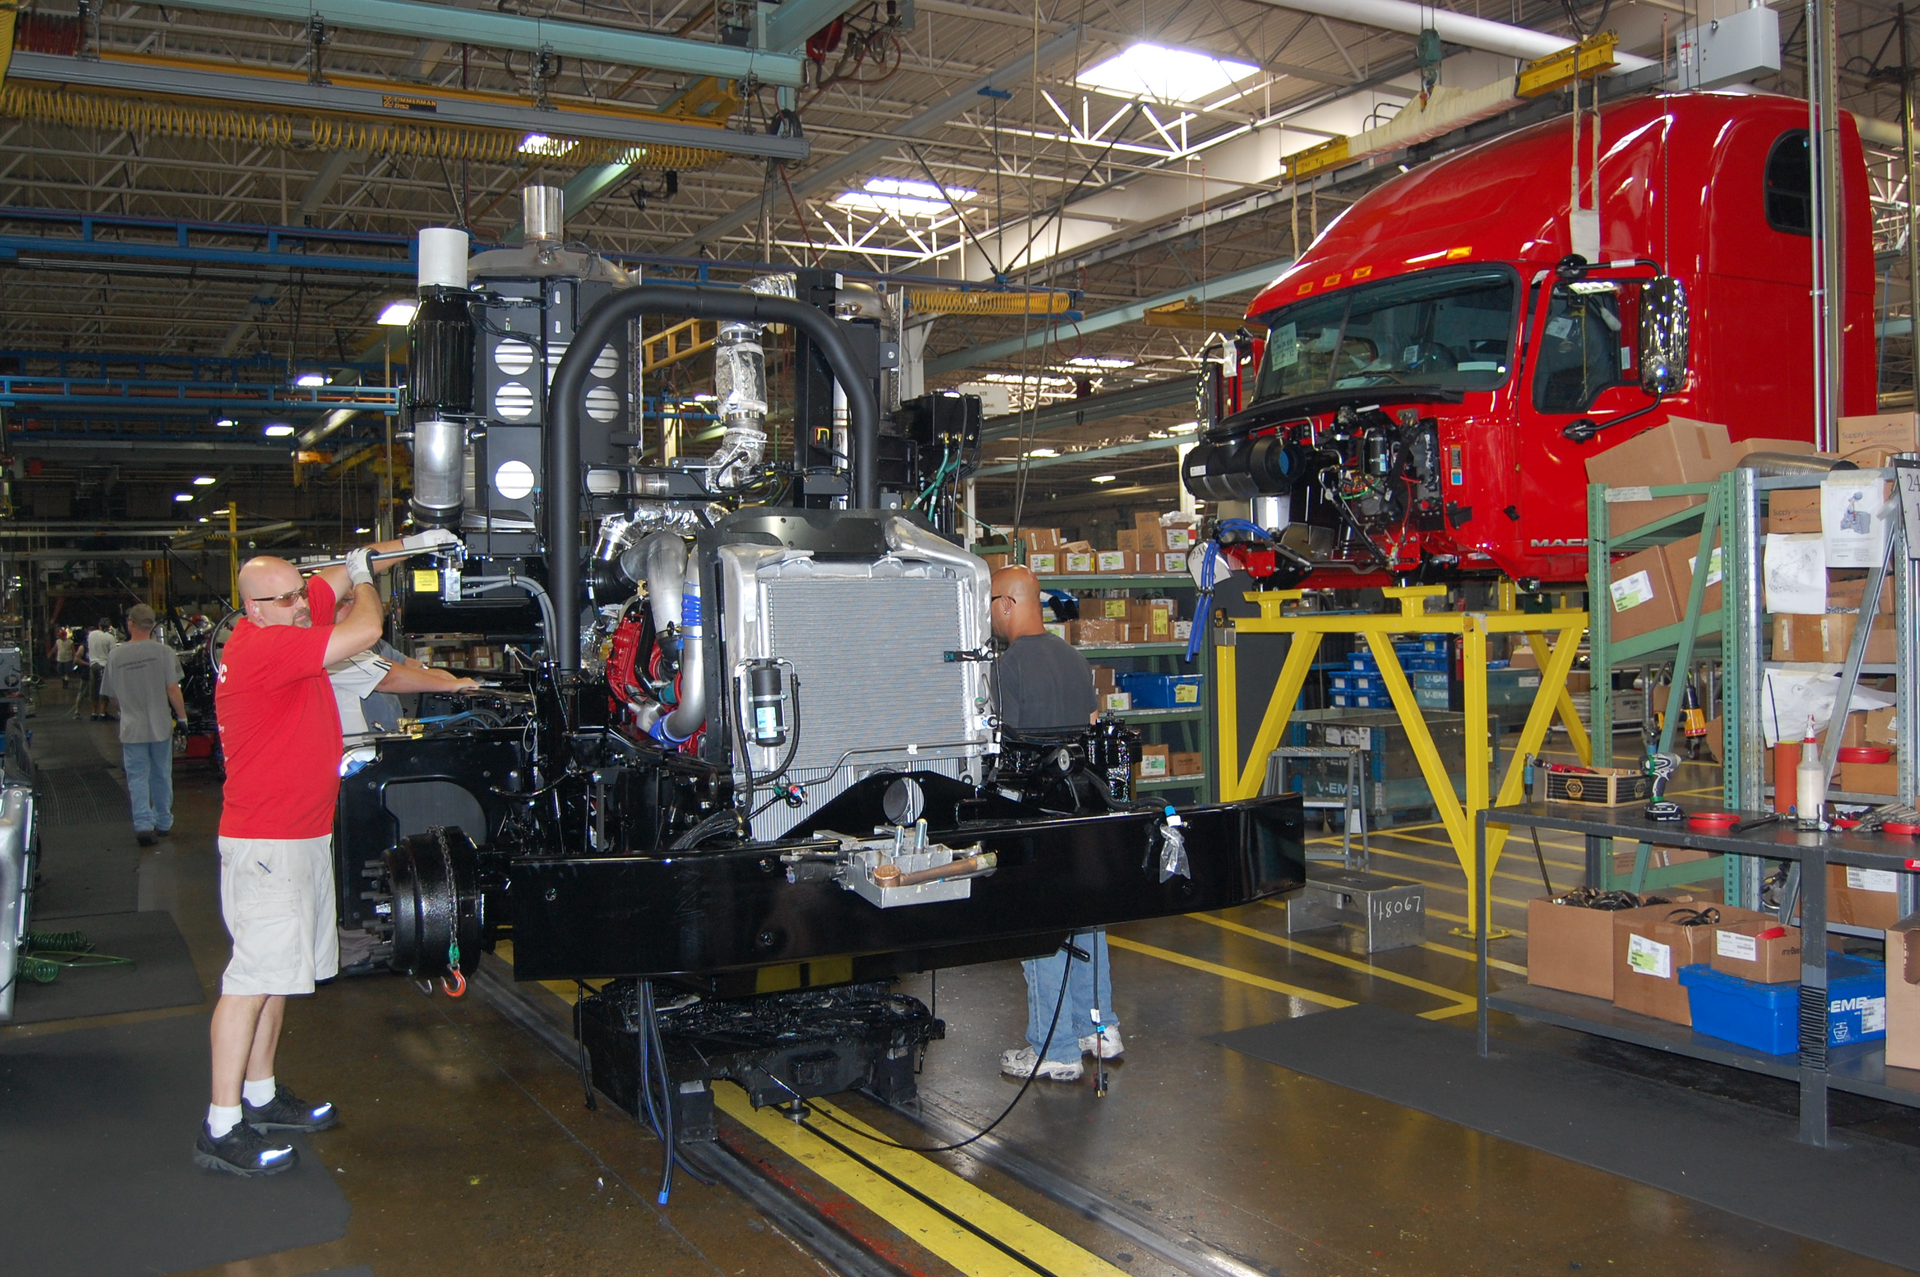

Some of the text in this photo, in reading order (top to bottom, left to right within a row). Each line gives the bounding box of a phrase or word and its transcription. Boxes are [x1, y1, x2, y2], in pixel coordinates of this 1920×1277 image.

[393, 97, 437, 106] ZIMMERMAN
[1842, 432, 1864, 440] Supply
[1773, 509, 1791, 517] Supply
